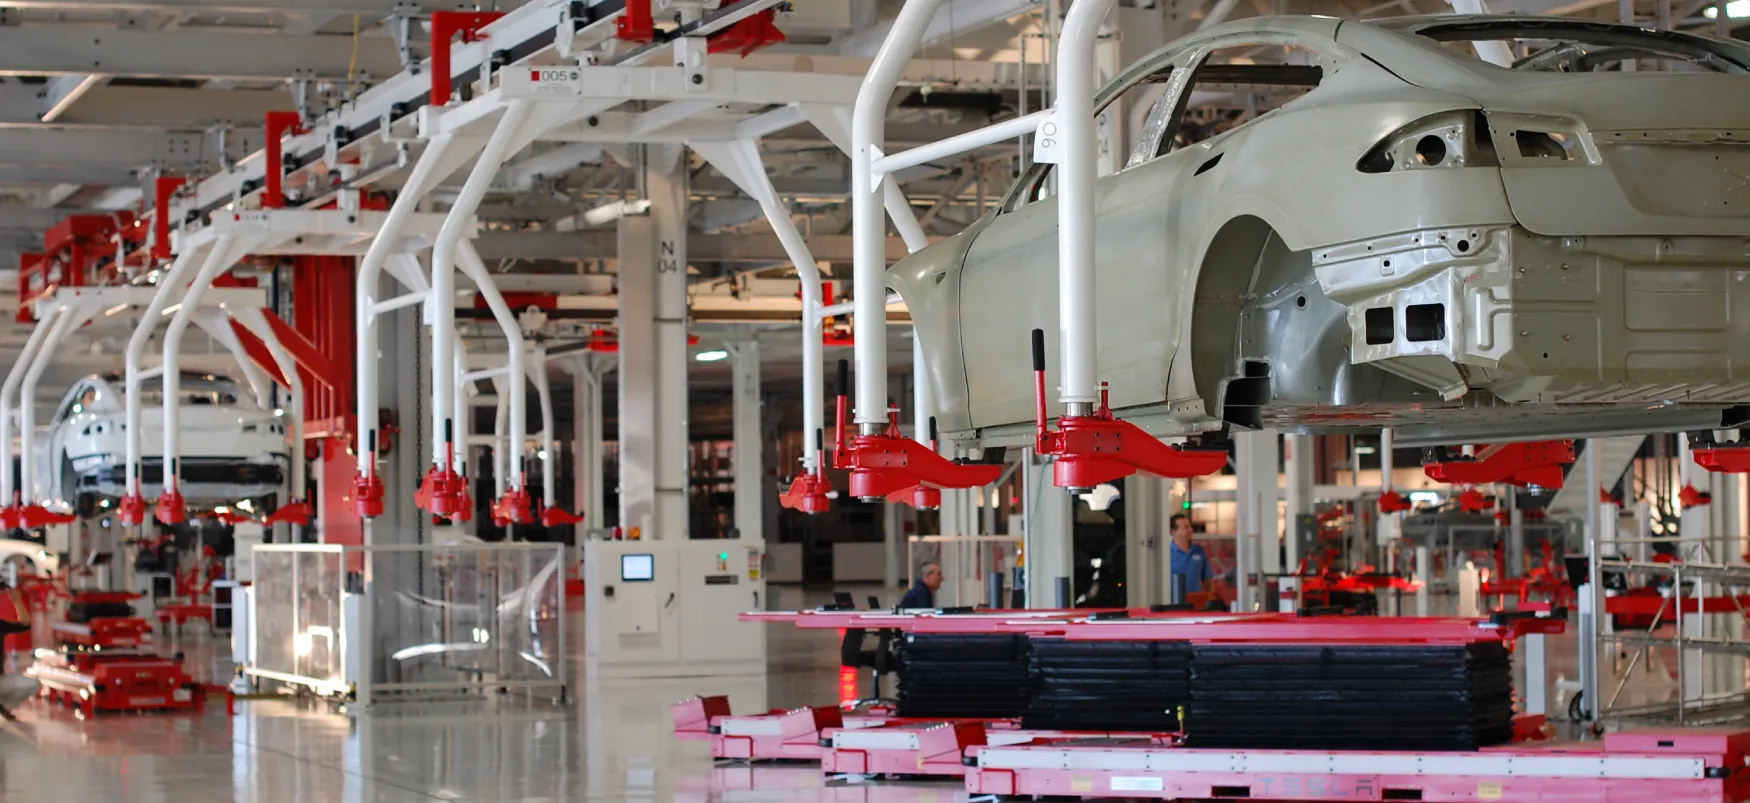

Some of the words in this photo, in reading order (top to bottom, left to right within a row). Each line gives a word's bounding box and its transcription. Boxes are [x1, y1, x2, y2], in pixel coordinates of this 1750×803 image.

[541, 70, 568, 81] 005
[661, 240, 675, 256] N
[658, 259, 677, 274] 04
[1260, 778, 1373, 796] TESLA
